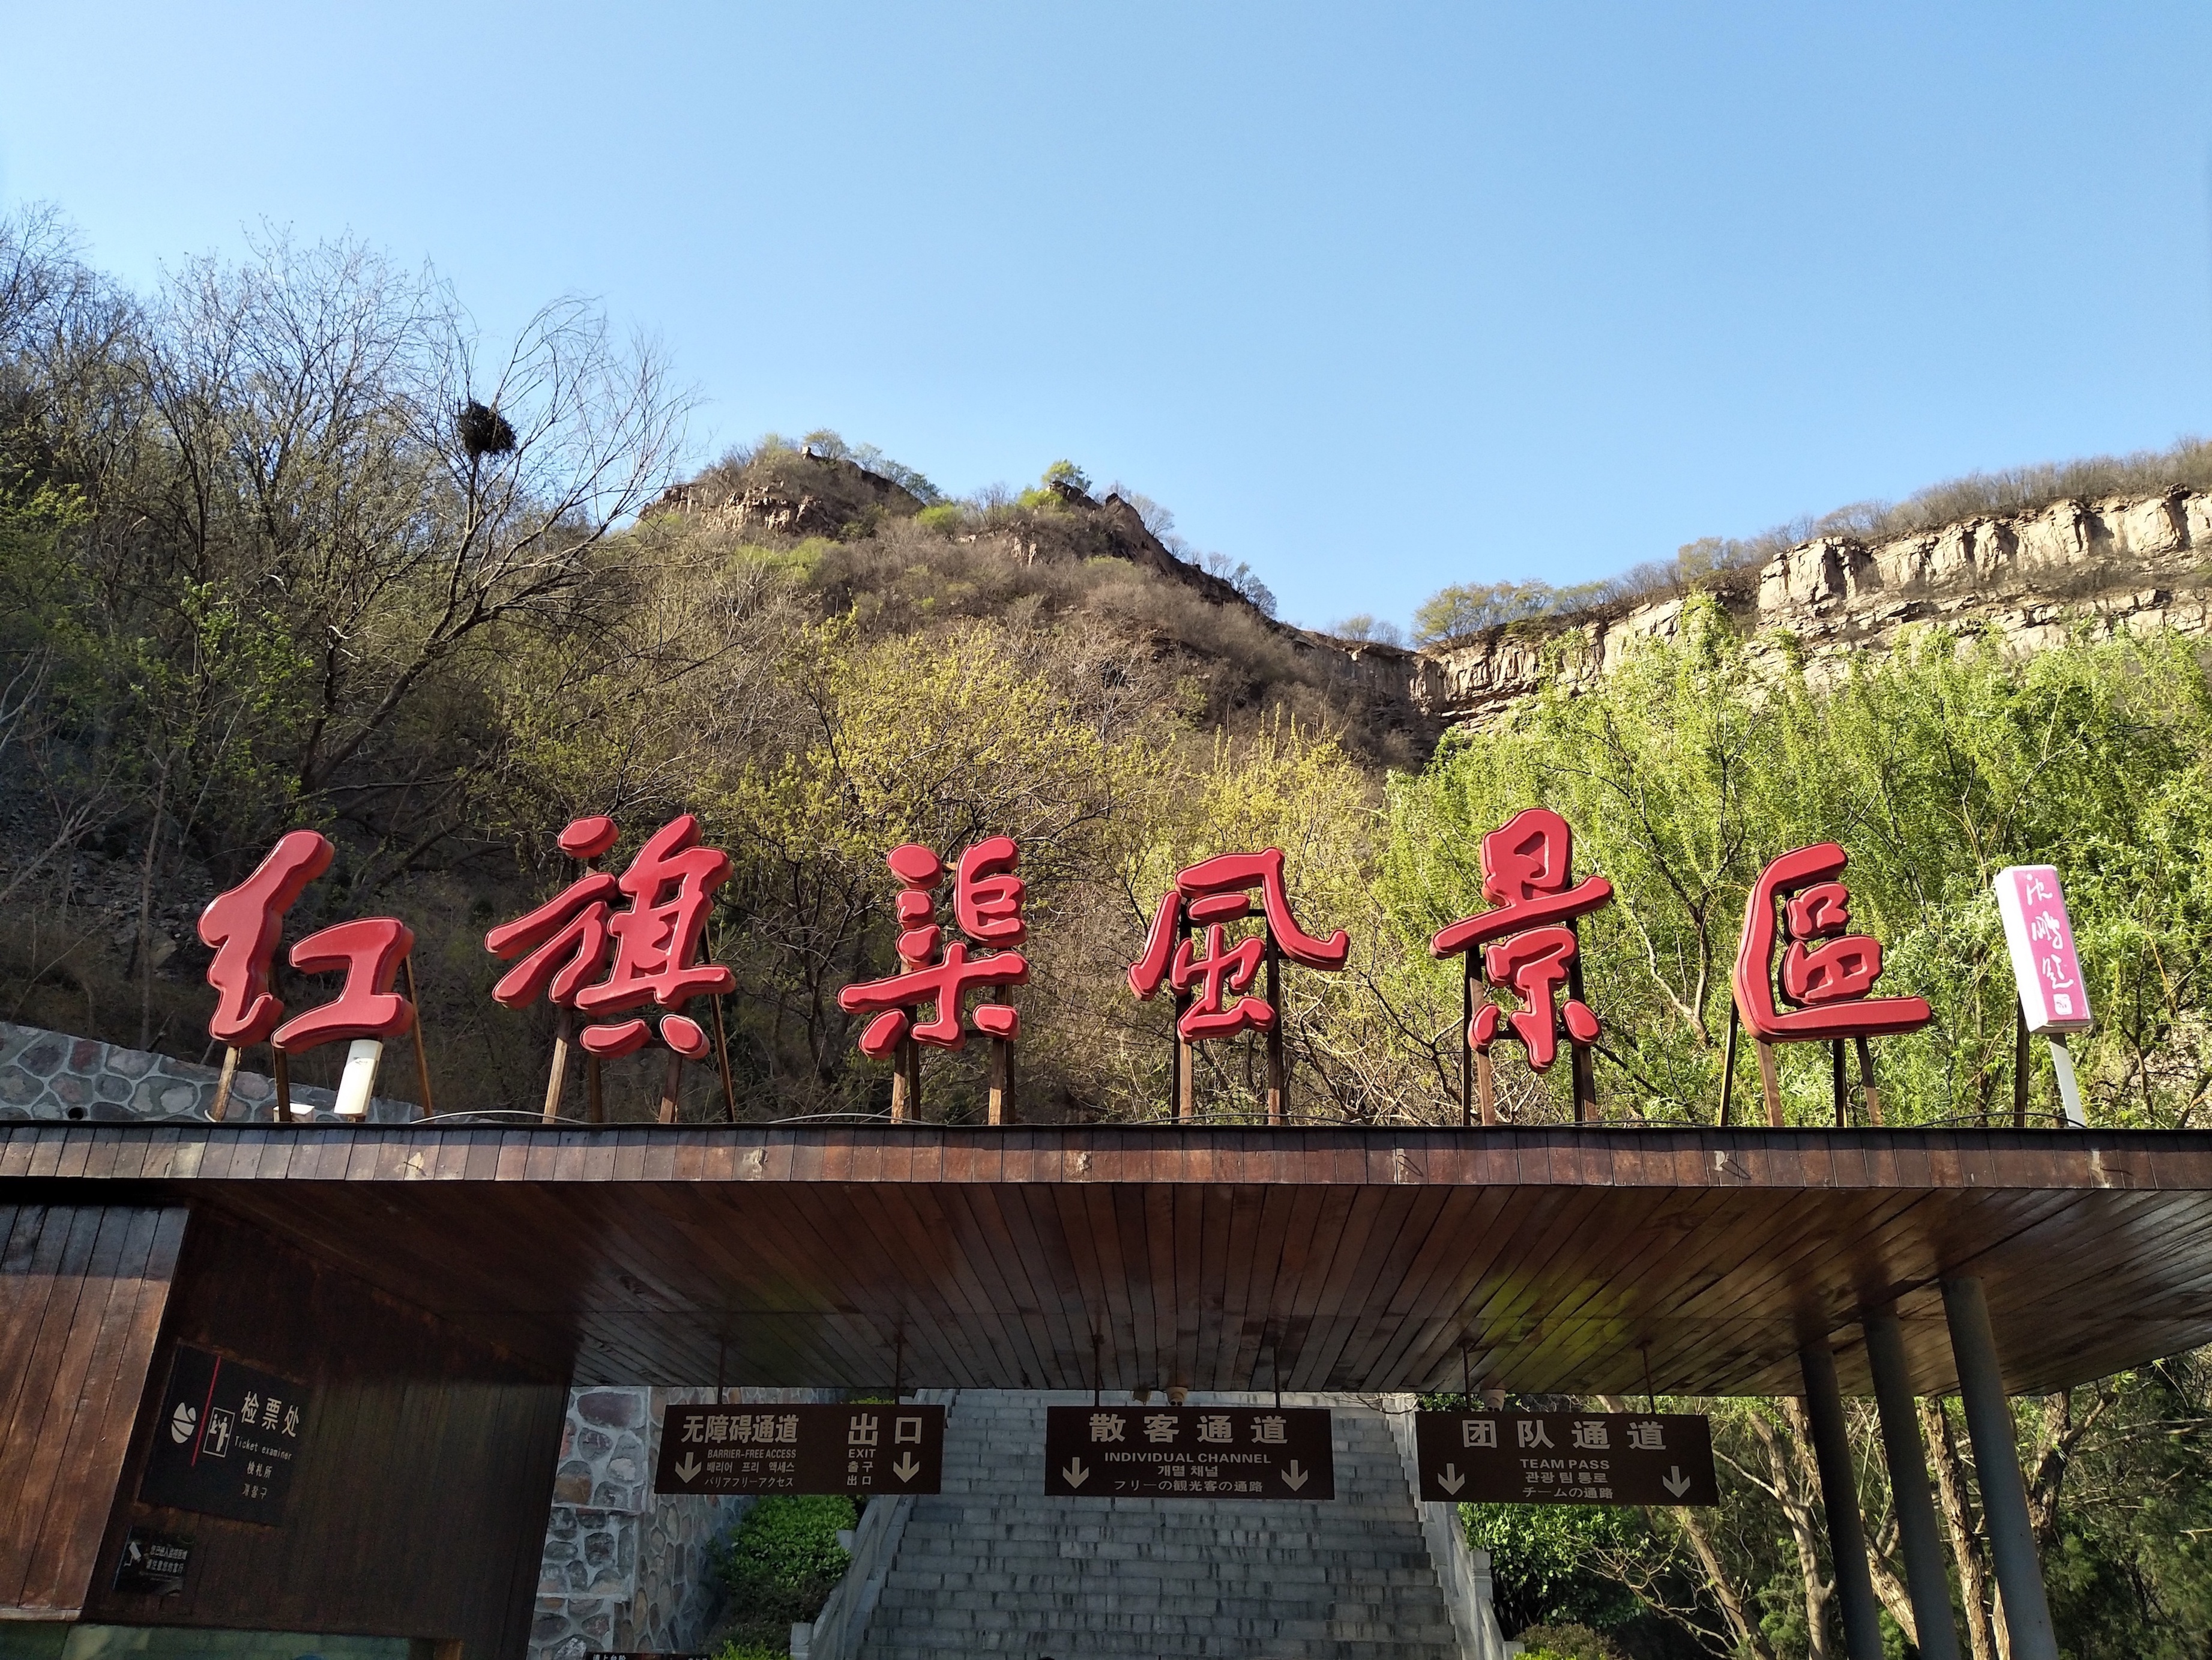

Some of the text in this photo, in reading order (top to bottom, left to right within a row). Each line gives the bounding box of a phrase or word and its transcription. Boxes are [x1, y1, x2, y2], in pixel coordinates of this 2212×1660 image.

[241, 1391, 300, 1437] 检票处
[681, 1414, 799, 1444] 无障碍通道
[848, 1413, 922, 1446] 出口
[1089, 1413, 1288, 1444] 散客通道
[1462, 1419, 1667, 1450] 团队通道
[235, 1435, 292, 1460] Ticket examiner
[707, 1449, 797, 1458] BARRIER-FREE ACCESS
[848, 1449, 876, 1458] EXIT
[1104, 1452, 1271, 1464] INDIVIDUAL CHANNEL
[1520, 1459, 1610, 1470] TEAM PASS
[707, 1461, 733, 1473] 배리어
[741, 1461, 759, 1473] 프리
[1190, 1465, 1218, 1477] 채널
[847, 1474, 872, 1486] 出口
[1525, 1471, 1555, 1483] 관광
[1578, 1472, 1608, 1484] 통로
[1522, 1486, 1614, 1499] チームの通路
